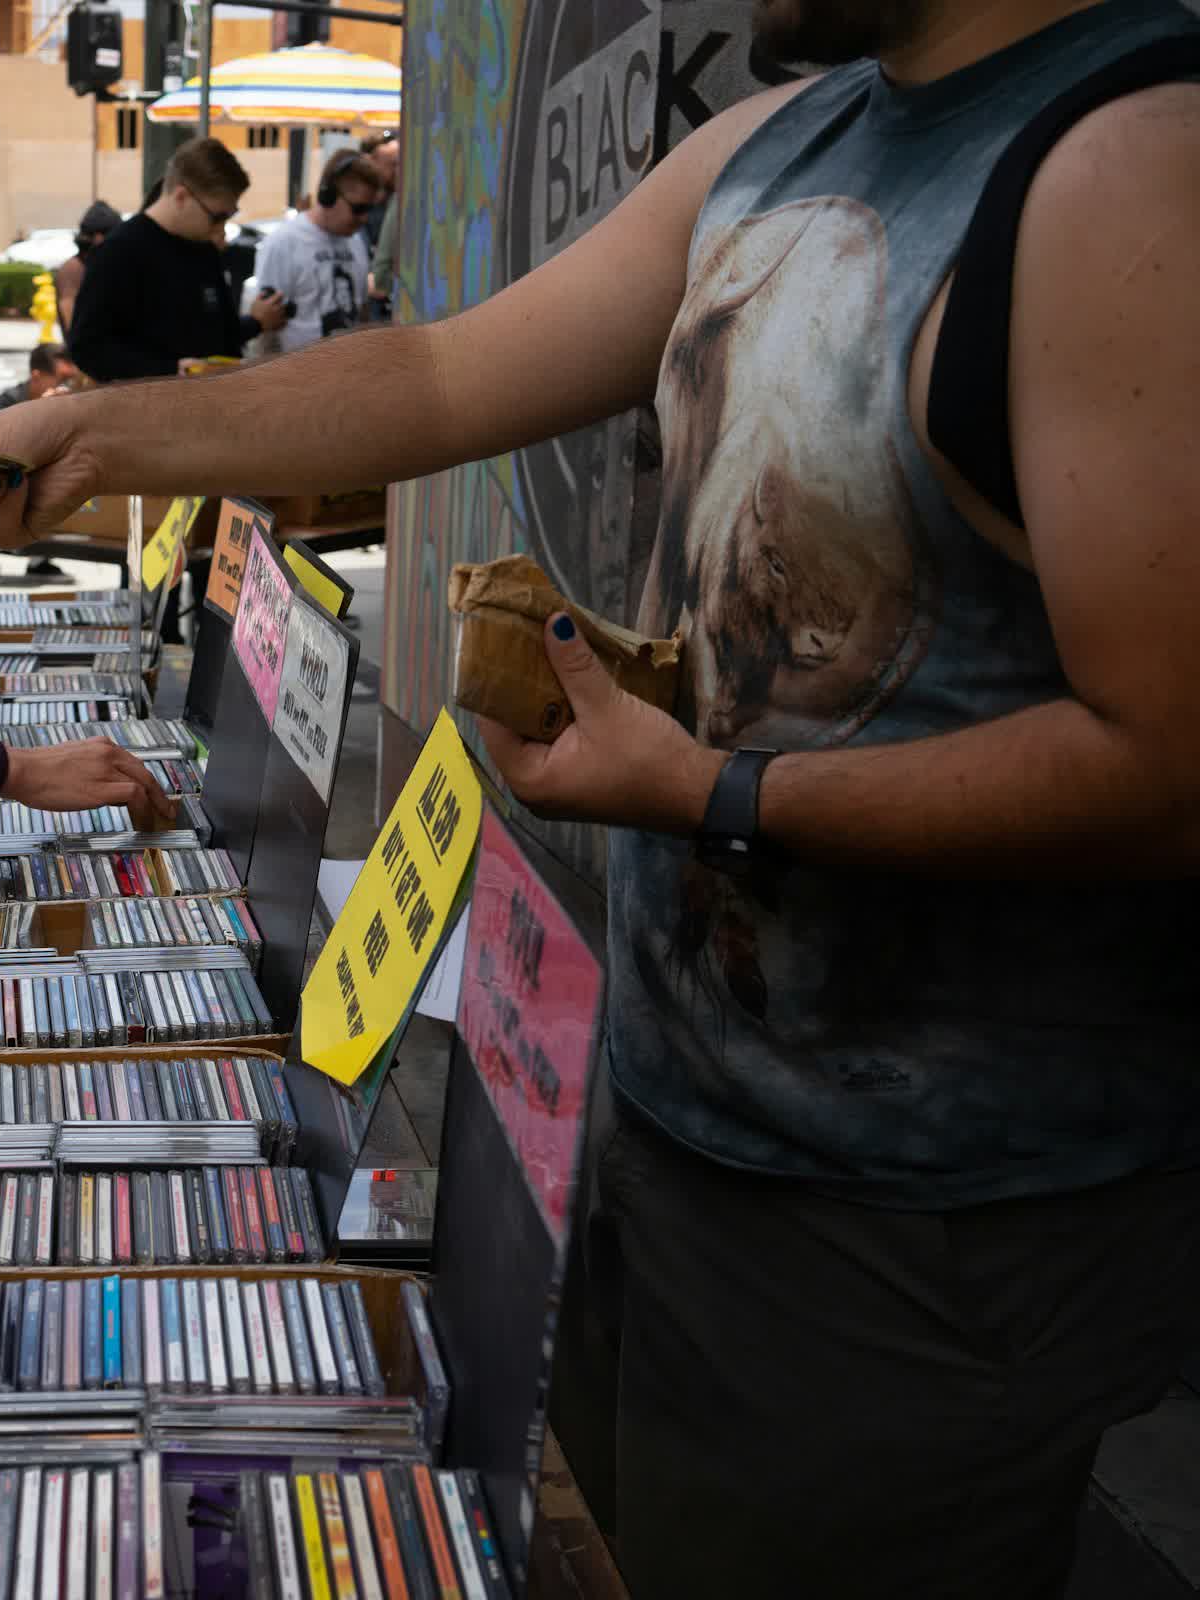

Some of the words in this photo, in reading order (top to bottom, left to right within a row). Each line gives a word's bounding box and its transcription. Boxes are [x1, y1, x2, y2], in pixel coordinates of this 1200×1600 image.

[545, 31, 734, 245] BLACK
[418, 762, 447, 825] ALL
[381, 820, 405, 875] BUY
[391, 850, 410, 888] 1
[395, 860, 421, 916] GET
[363, 908, 390, 979] FREE!
[406, 890, 435, 955] ONE
